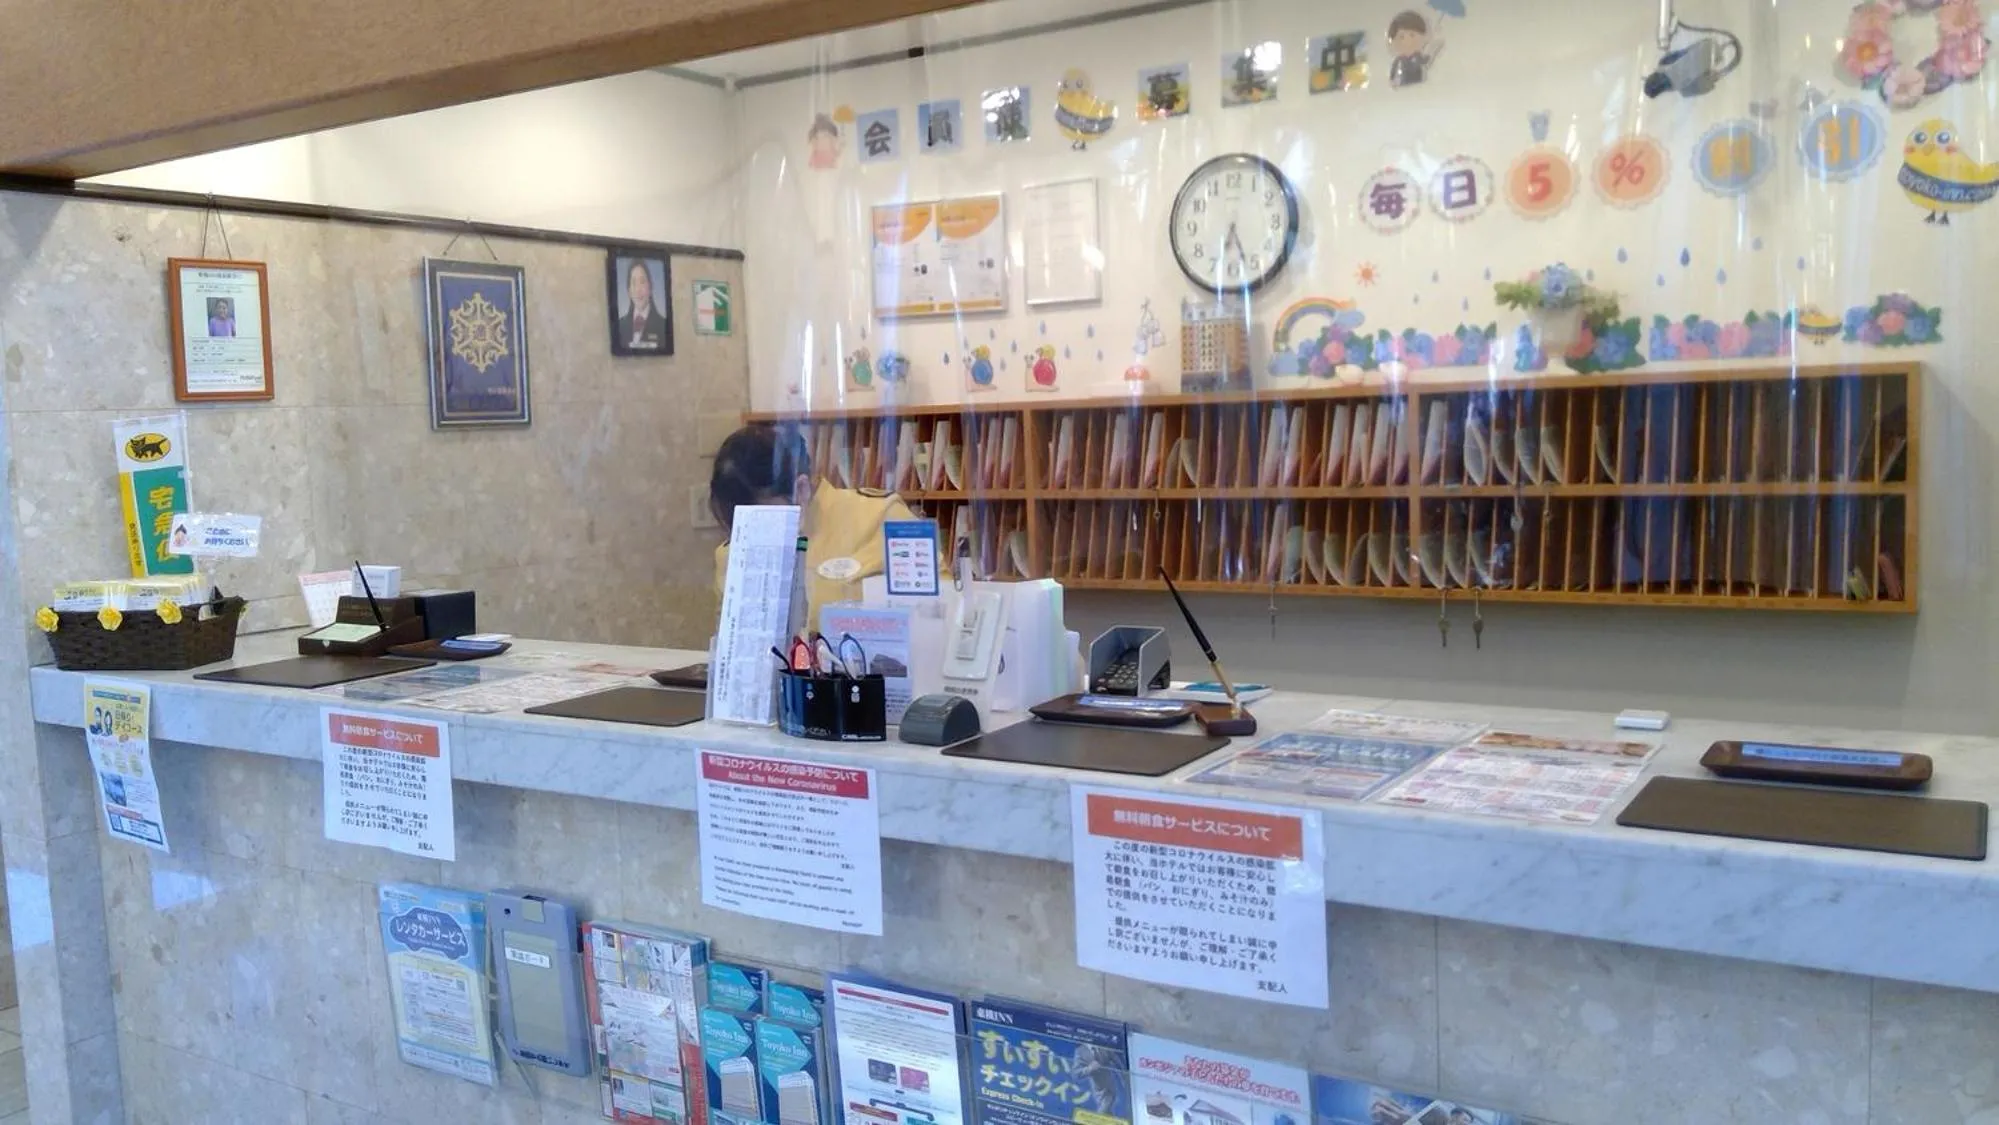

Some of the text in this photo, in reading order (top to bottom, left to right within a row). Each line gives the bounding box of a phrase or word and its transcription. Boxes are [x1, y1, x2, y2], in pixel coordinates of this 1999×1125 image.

[768, 775, 785, 785] New
[1113, 808, 1272, 841] 無料朝食サービスについて
[395, 919, 466, 946] レンタカーサービス
[1257, 980, 1286, 994] 支配人
[977, 1029, 1071, 1075] すいすい
[980, 1064, 1091, 1104] チェックイン
